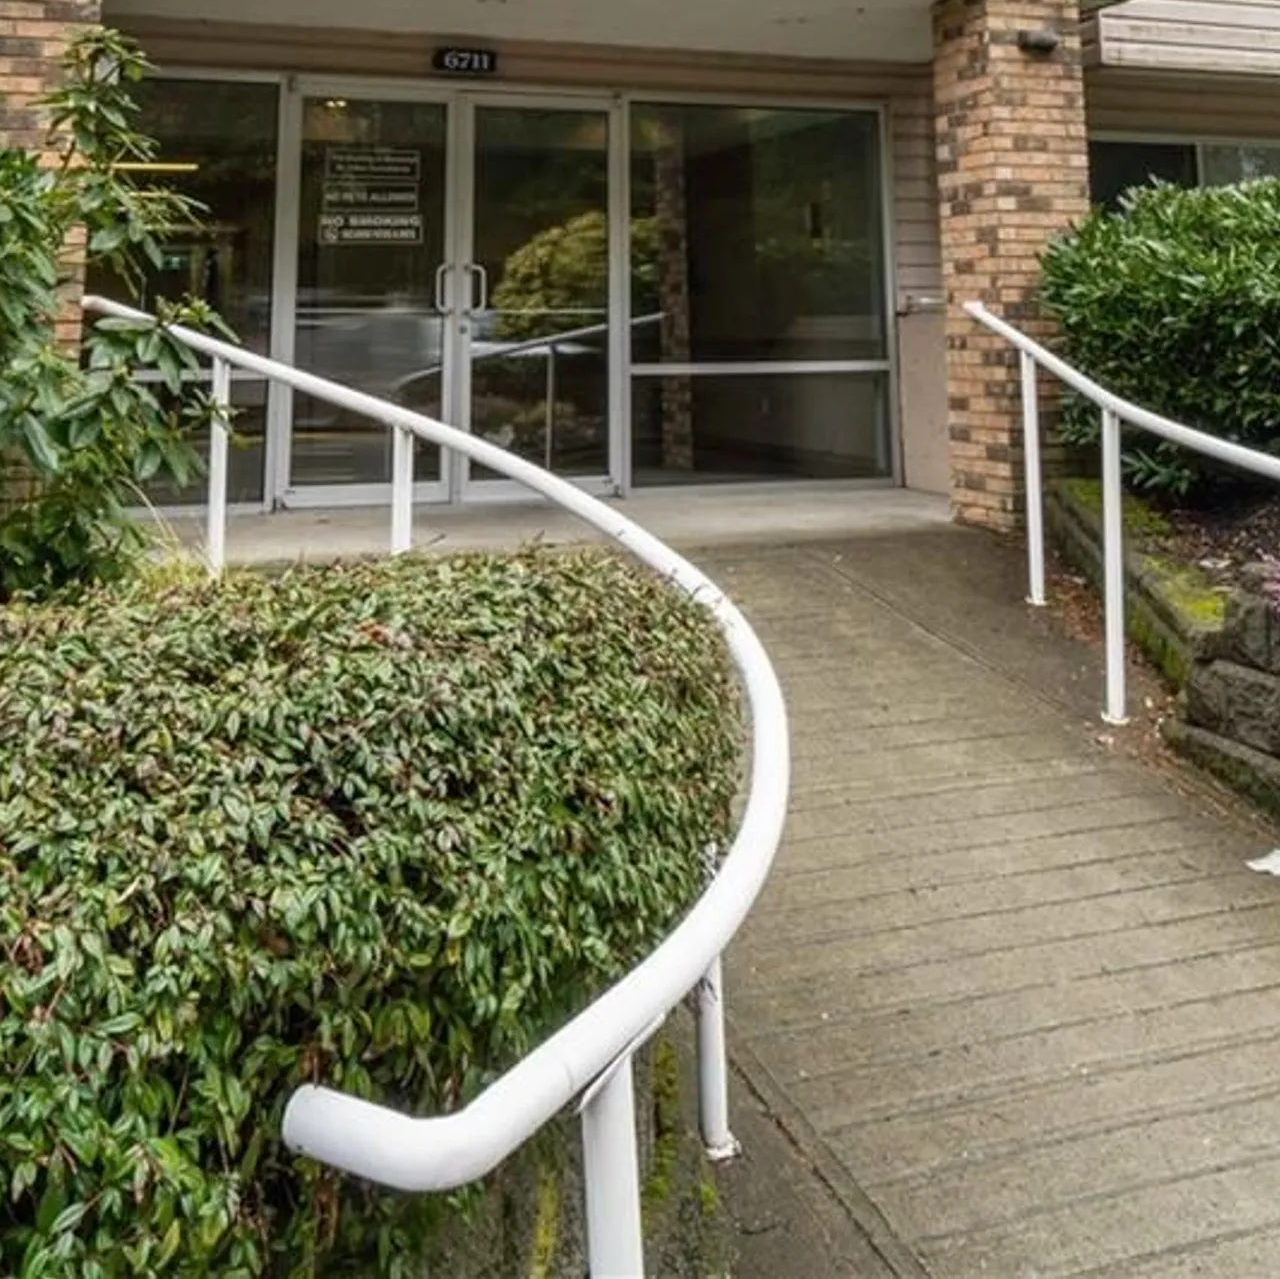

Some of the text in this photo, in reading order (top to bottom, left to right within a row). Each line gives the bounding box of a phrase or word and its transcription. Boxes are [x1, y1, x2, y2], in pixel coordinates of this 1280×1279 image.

[444, 51, 489, 70] 6711
[320, 215, 420, 227] NO SMOKING
